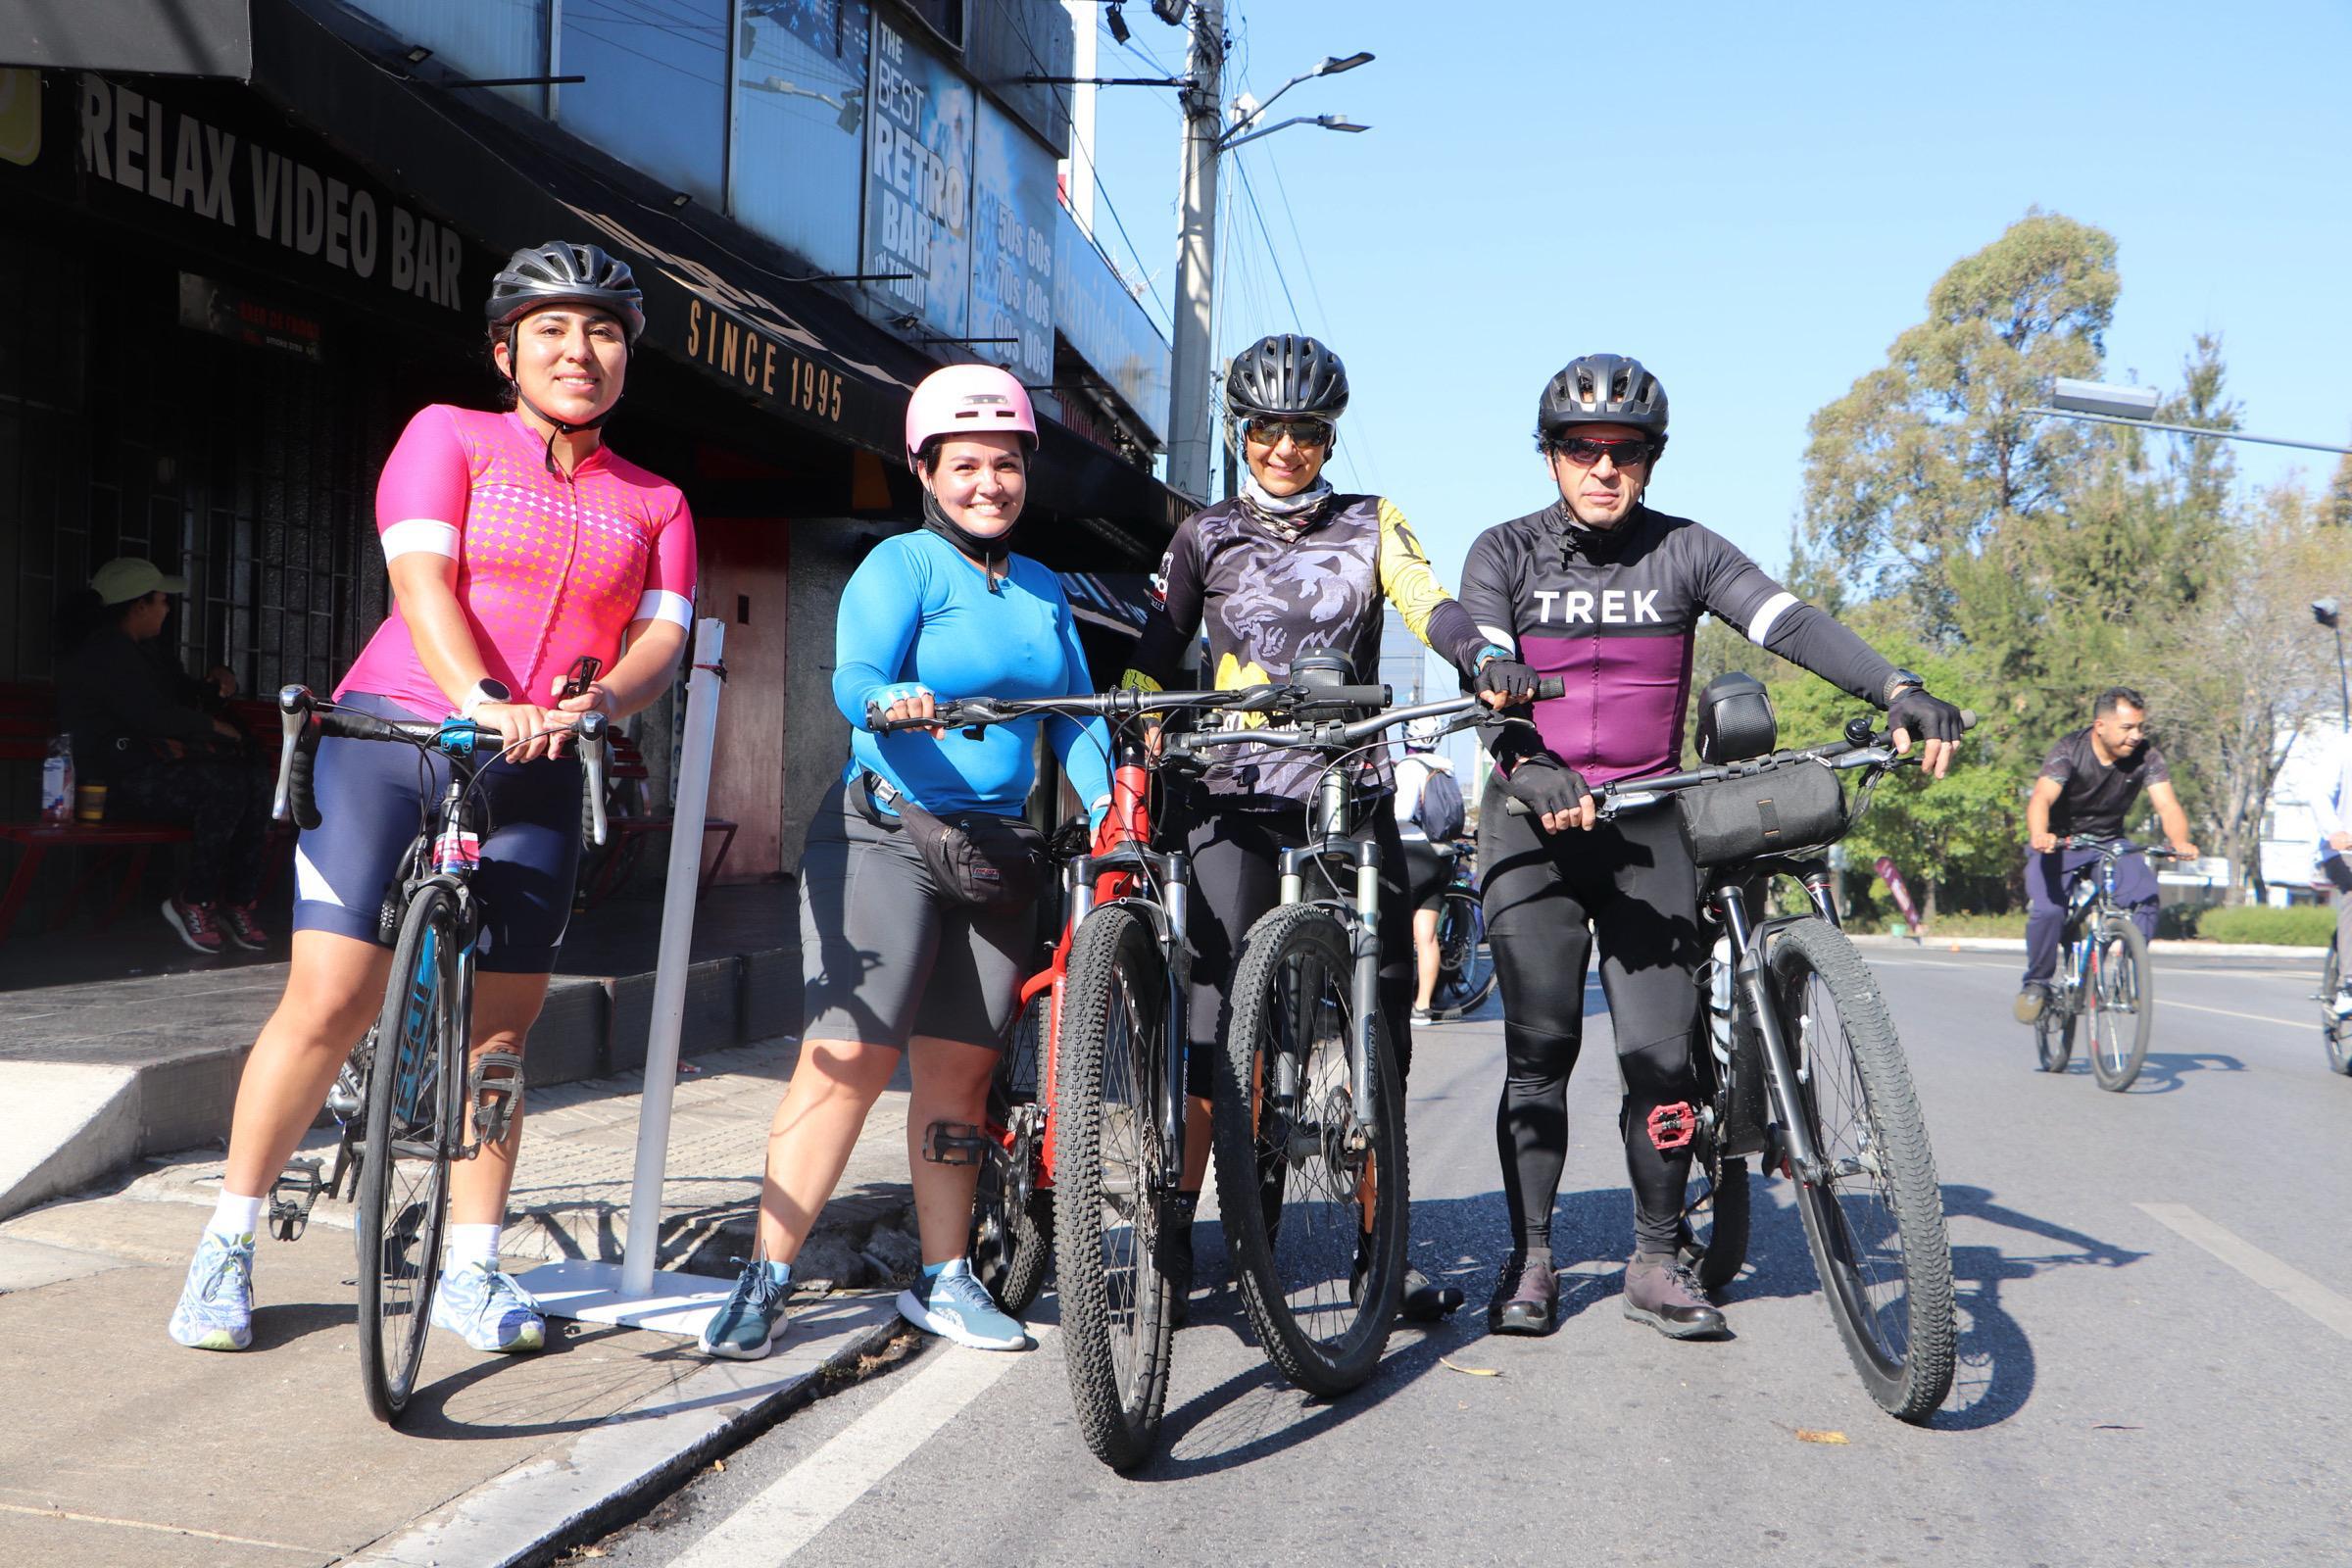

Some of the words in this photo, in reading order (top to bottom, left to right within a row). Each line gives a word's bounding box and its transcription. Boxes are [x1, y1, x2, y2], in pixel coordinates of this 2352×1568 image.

[880, 23, 904, 66] THE
[877, 58, 924, 134] BEST
[80, 74, 236, 226] RELAX
[251, 142, 377, 279] VIDEO
[391, 204, 463, 313] BAR
[873, 112, 965, 230] RETRO
[882, 188, 932, 274] BAR
[875, 250, 888, 277] IN
[888, 257, 926, 310] TOWN
[687, 298, 777, 396] SINCE
[790, 356, 843, 422] 1995
[1533, 589, 1663, 624] TREK
